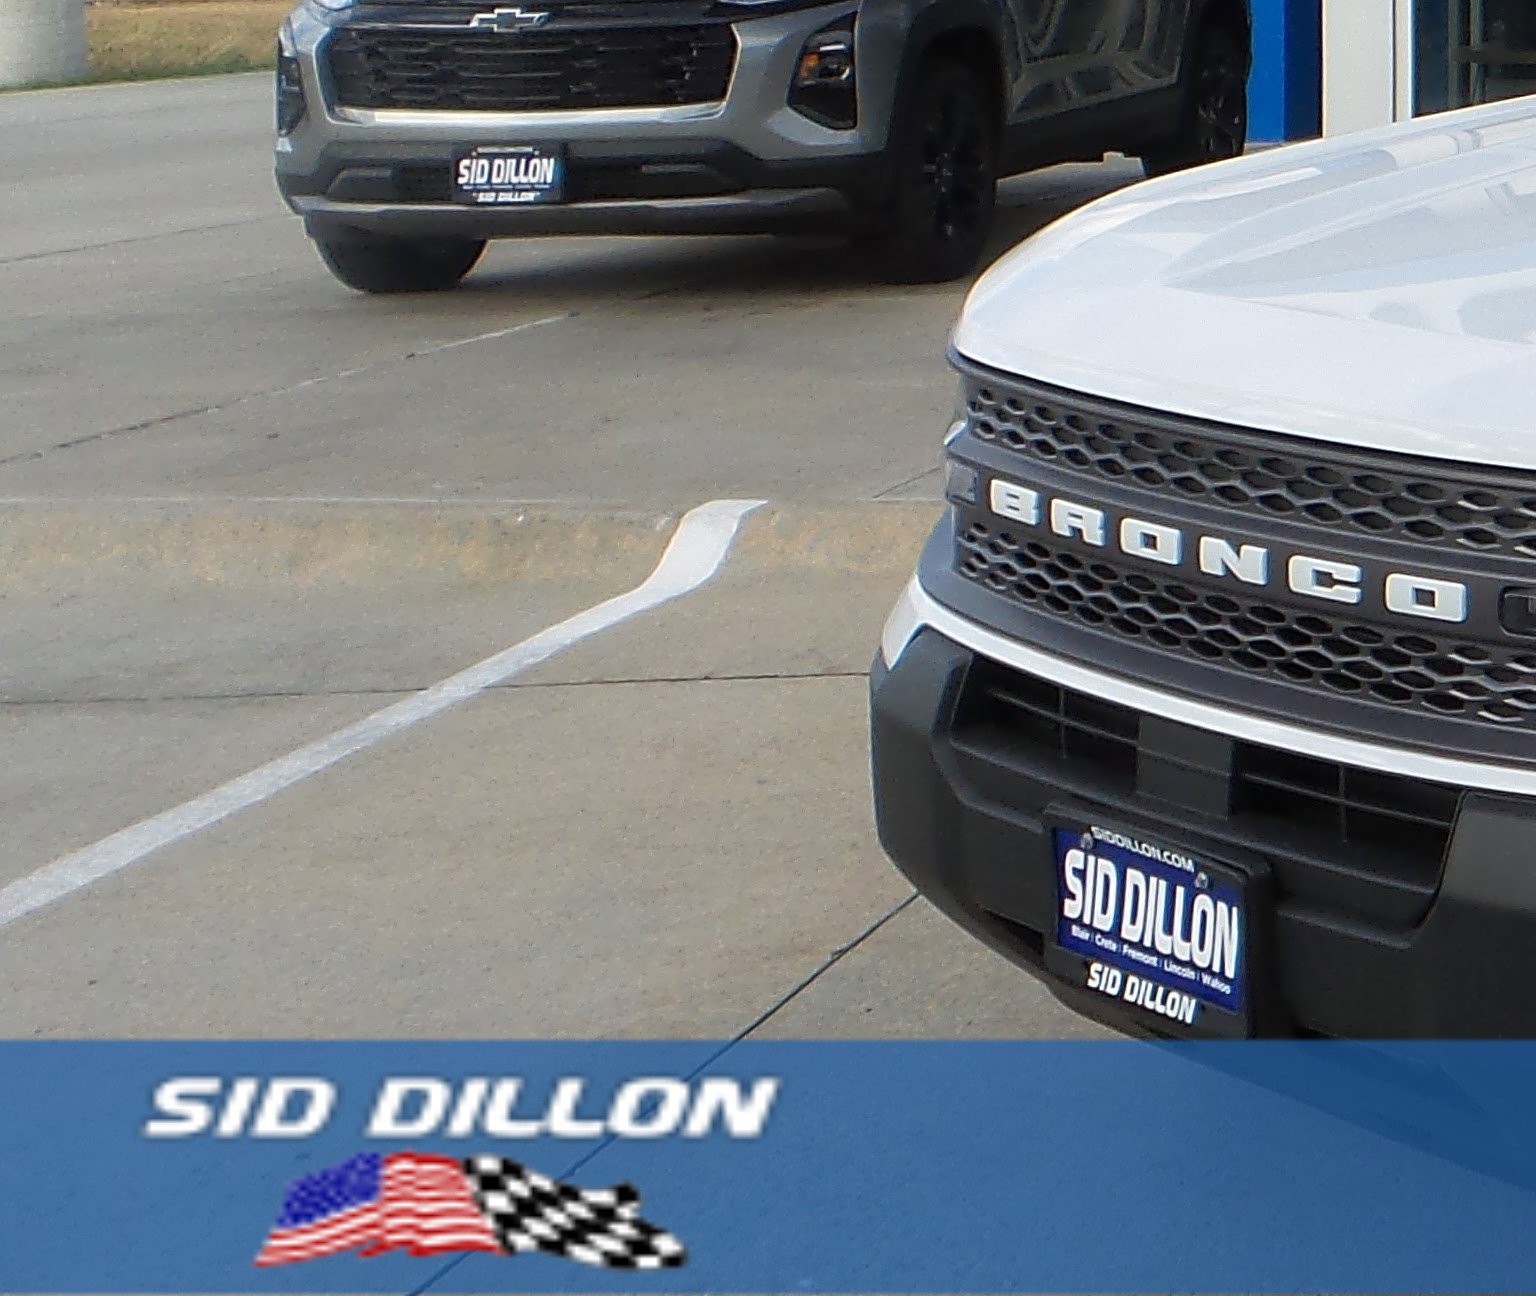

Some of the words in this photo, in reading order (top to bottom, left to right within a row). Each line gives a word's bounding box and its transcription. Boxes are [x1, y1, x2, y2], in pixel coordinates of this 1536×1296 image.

[457, 158, 490, 184] SID
[491, 158, 555, 184] DILLON
[989, 477, 1468, 623] BRONCO
[1063, 848, 1118, 933] SID
[1120, 867, 1239, 980] DILLON
[1087, 961, 1122, 997] SID
[1122, 974, 1197, 1025] DILLON
